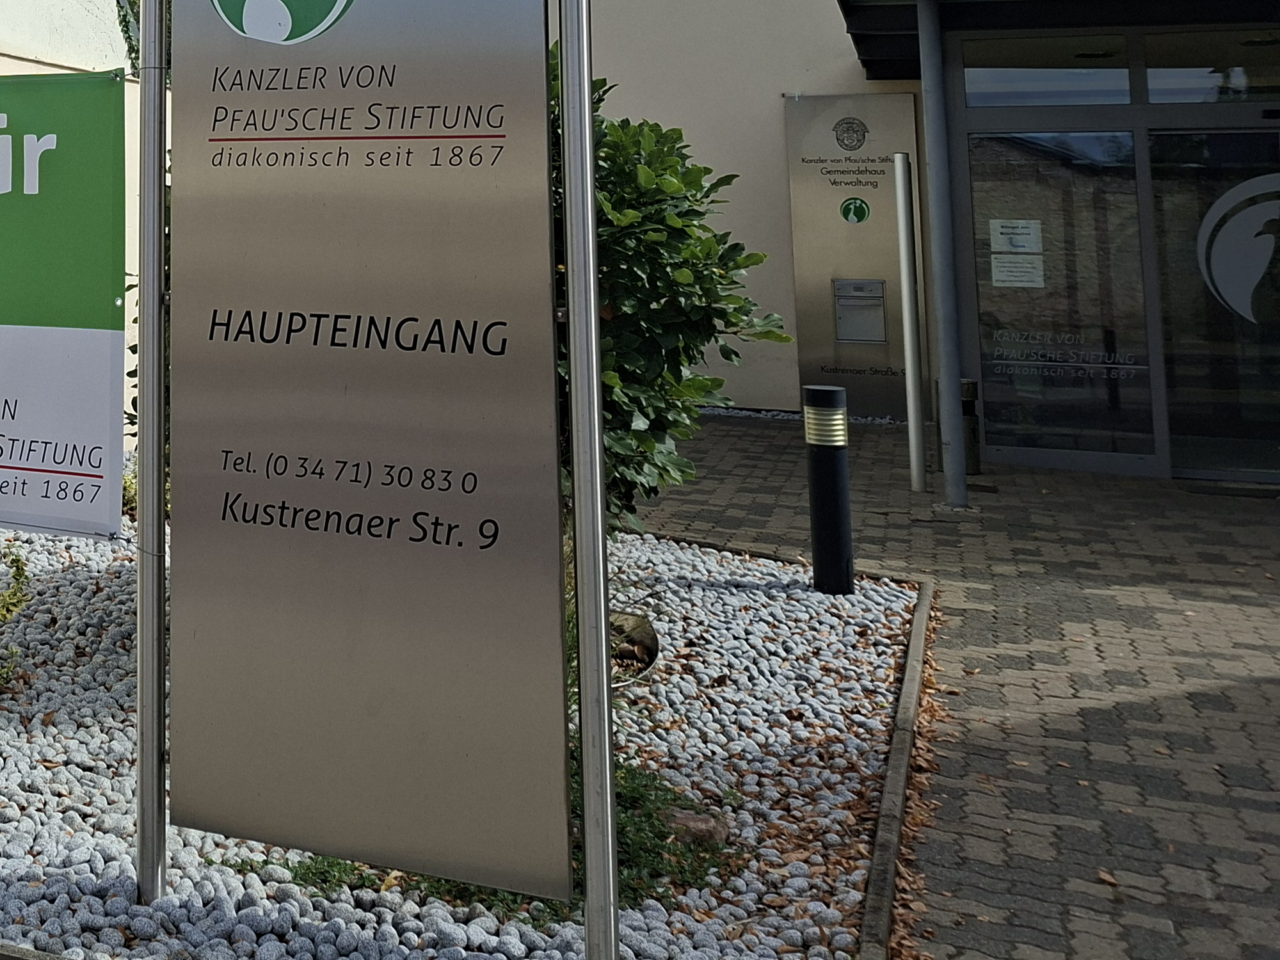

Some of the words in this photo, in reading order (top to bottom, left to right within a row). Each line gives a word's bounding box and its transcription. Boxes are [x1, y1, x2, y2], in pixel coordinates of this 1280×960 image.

[212, 66, 327, 92] KANZLER
[338, 64, 396, 89] VON
[212, 106, 355, 132] PFAU'SCHE
[364, 102, 505, 131] STIFTUNG
[211, 146, 350, 167] diakonisch
[364, 146, 414, 167] seit
[429, 145, 505, 167] 1867
[801, 156, 828, 164] Kanzler
[820, 166, 886, 176] Gemeindehaus
[828, 177, 879, 189] Verwaltung
[207, 308, 509, 358] HAUPTEINGANG
[1056, 333, 1085, 345] VON
[1068, 349, 1135, 364] STIFTUNG
[820, 365, 867, 375] Kustrenaer
[869, 366, 899, 377] Straße
[994, 365, 1064, 377] diakonisch
[1070, 367, 1094, 378] seit
[1101, 368, 1136, 379] 1867
[221, 449, 257, 474] Tel.
[265, 452, 288, 479] (0
[334, 459, 372, 489] 71)
[40, 479, 102, 504] 1867
[220, 491, 401, 540] Kustrenaer
[408, 511, 464, 548] Str.
[477, 518, 500, 550] 9
